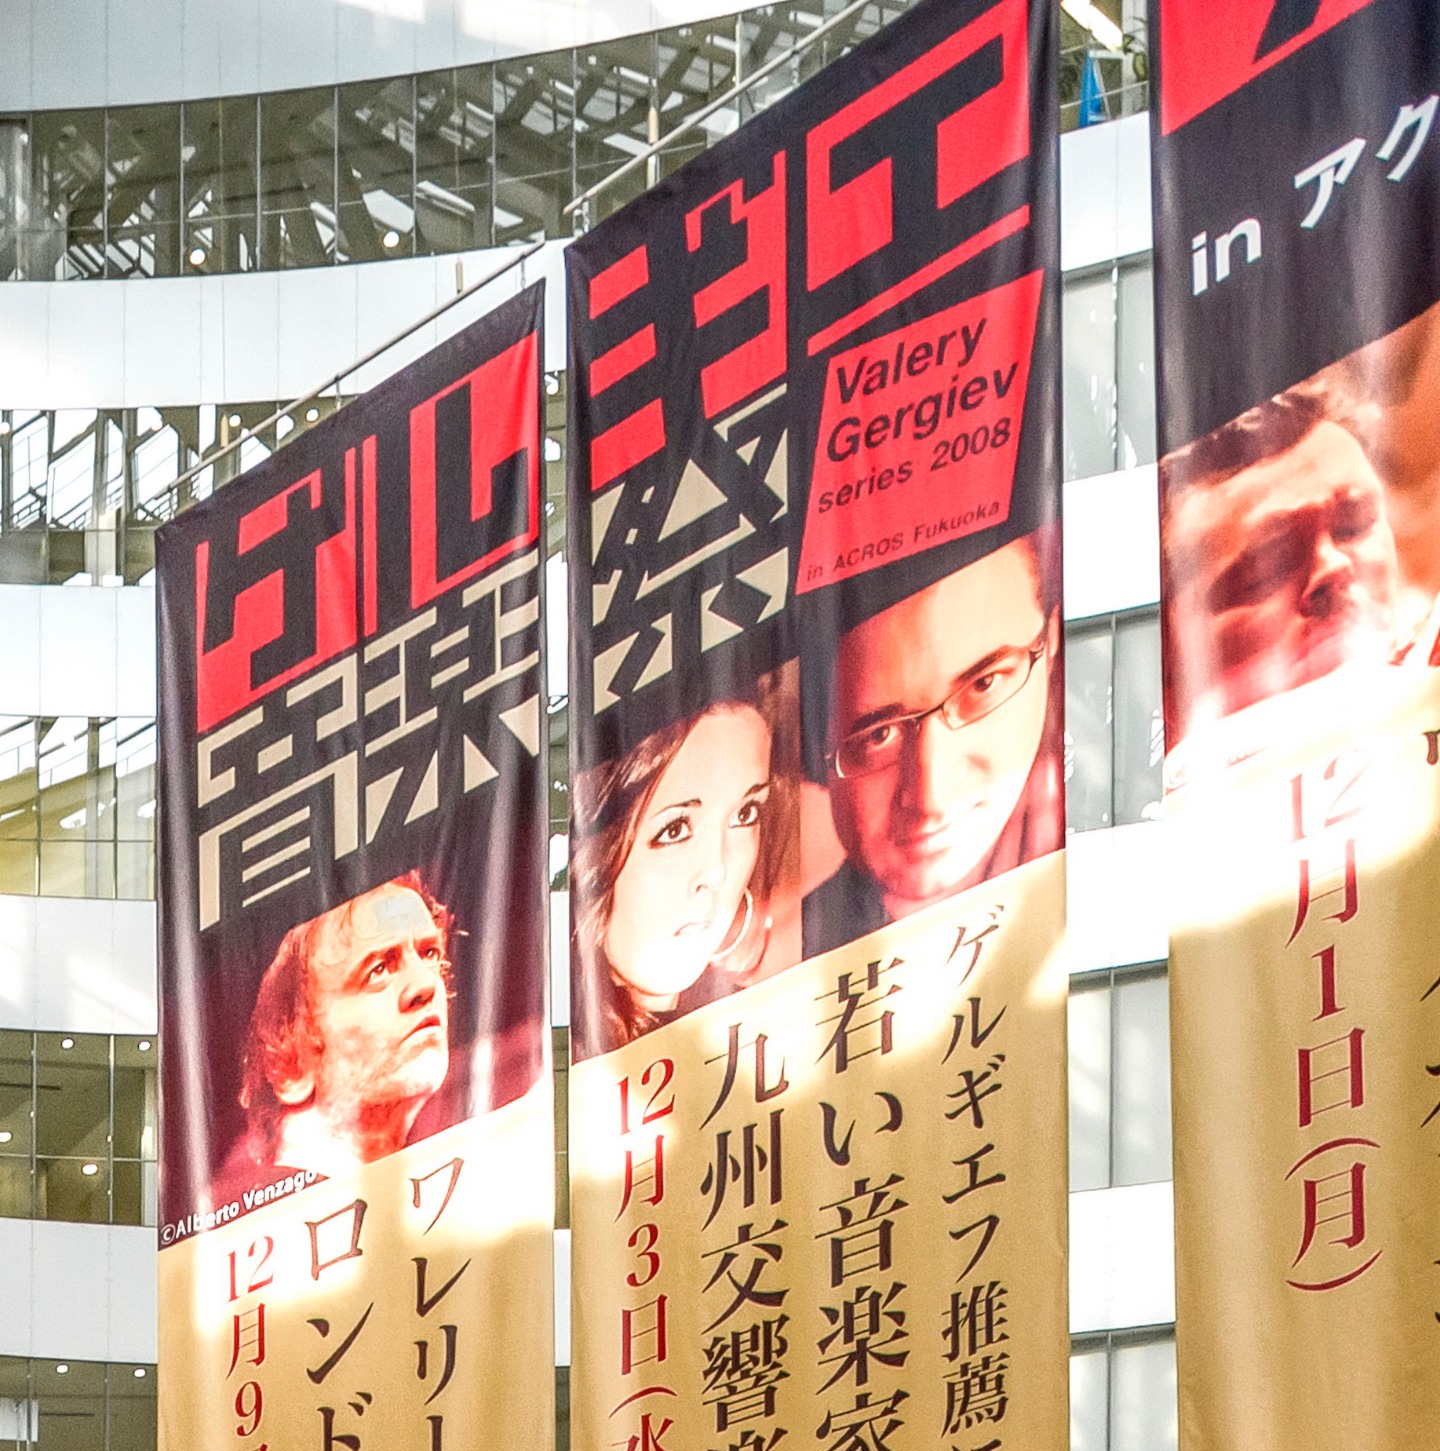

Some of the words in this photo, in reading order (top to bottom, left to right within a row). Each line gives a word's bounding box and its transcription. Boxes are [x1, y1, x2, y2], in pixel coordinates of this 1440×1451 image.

[1192, 218, 1261, 296] in
[837, 318, 987, 404] Valery
[828, 361, 1019, 462] Gergiev
[818, 461, 913, 514] series
[931, 417, 1010, 472] 2008
[807, 565, 823, 582] in
[834, 533, 904, 571] ACROS
[913, 501, 1000, 544] Fukuoka
[242, 1168, 318, 1211] Venzago
